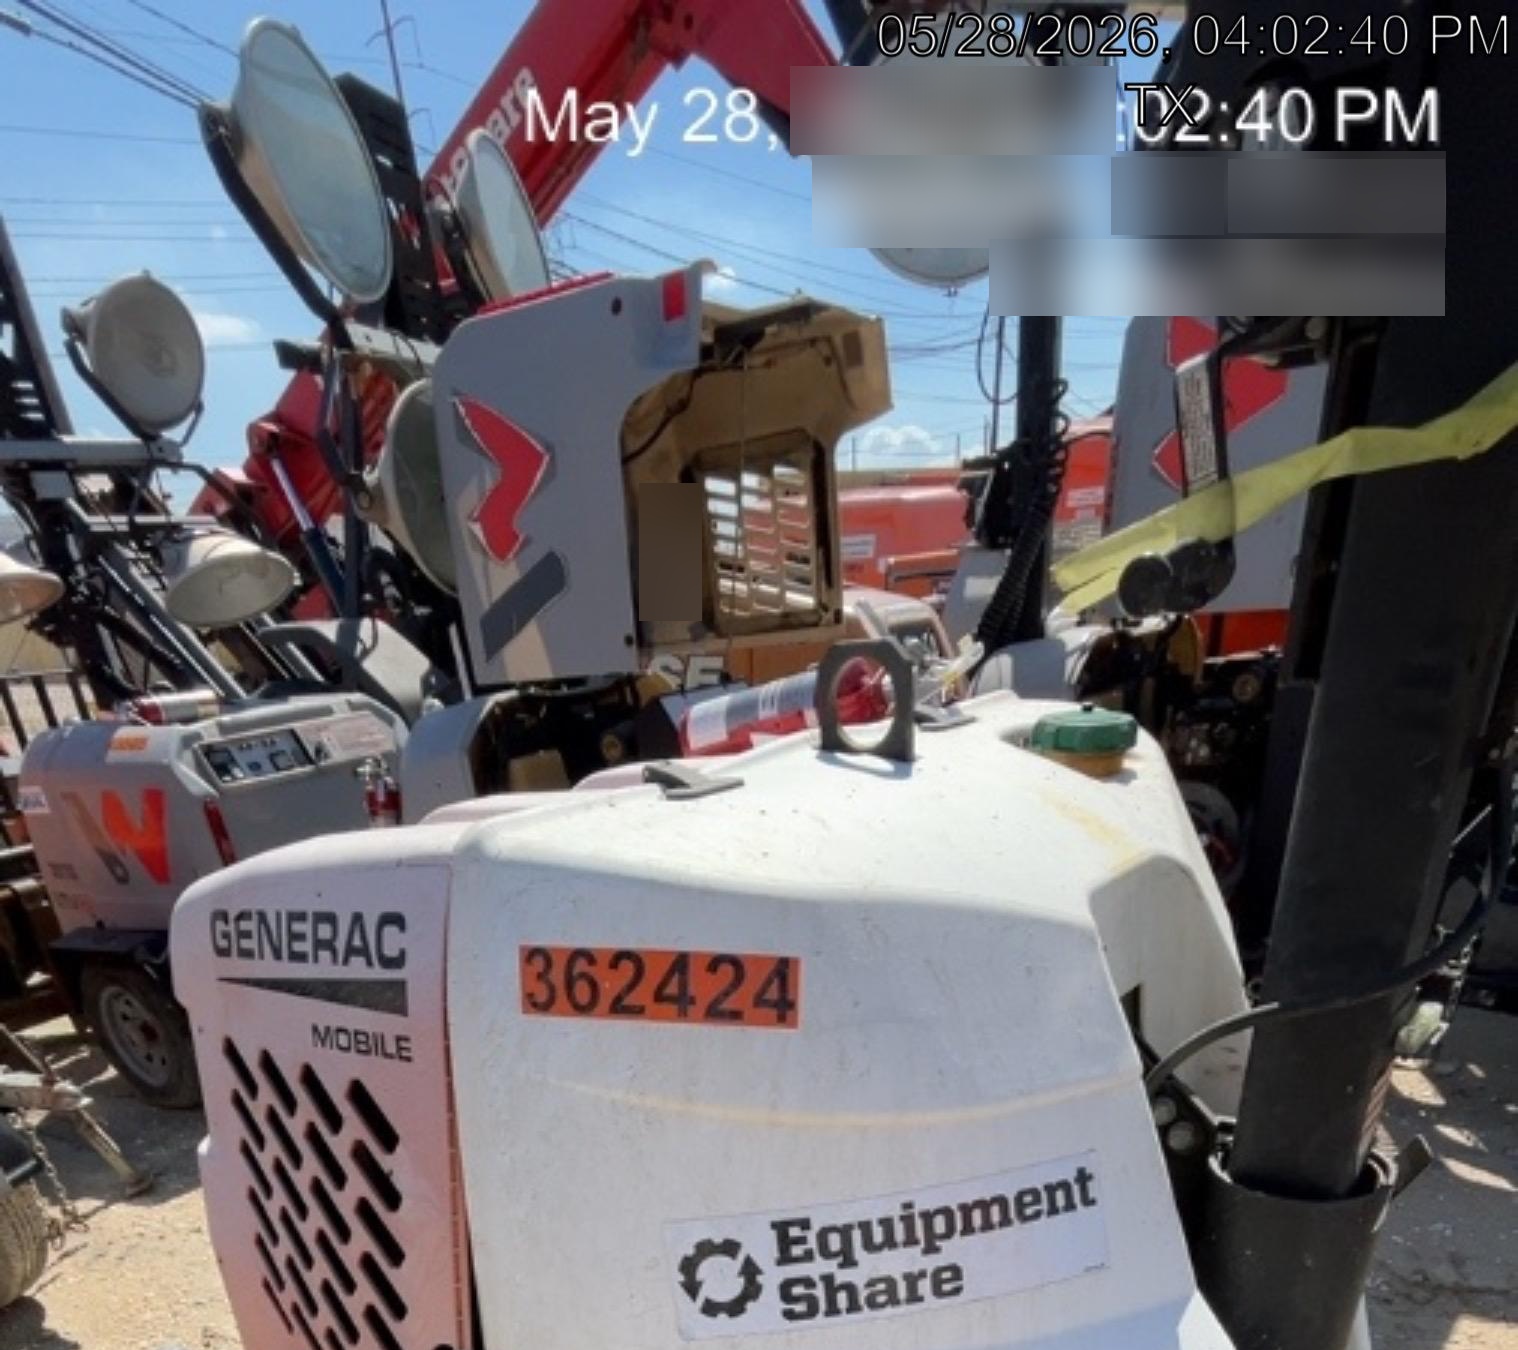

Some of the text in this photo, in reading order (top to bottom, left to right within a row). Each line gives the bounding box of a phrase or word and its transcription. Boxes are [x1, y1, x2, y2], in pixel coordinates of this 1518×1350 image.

[209, 908, 407, 970] GENERAC
[524, 945, 796, 1024] 362424
[311, 1023, 413, 1063] MOBILE
[770, 1165, 1098, 1270] Equipment
[777, 1262, 965, 1322] Share
